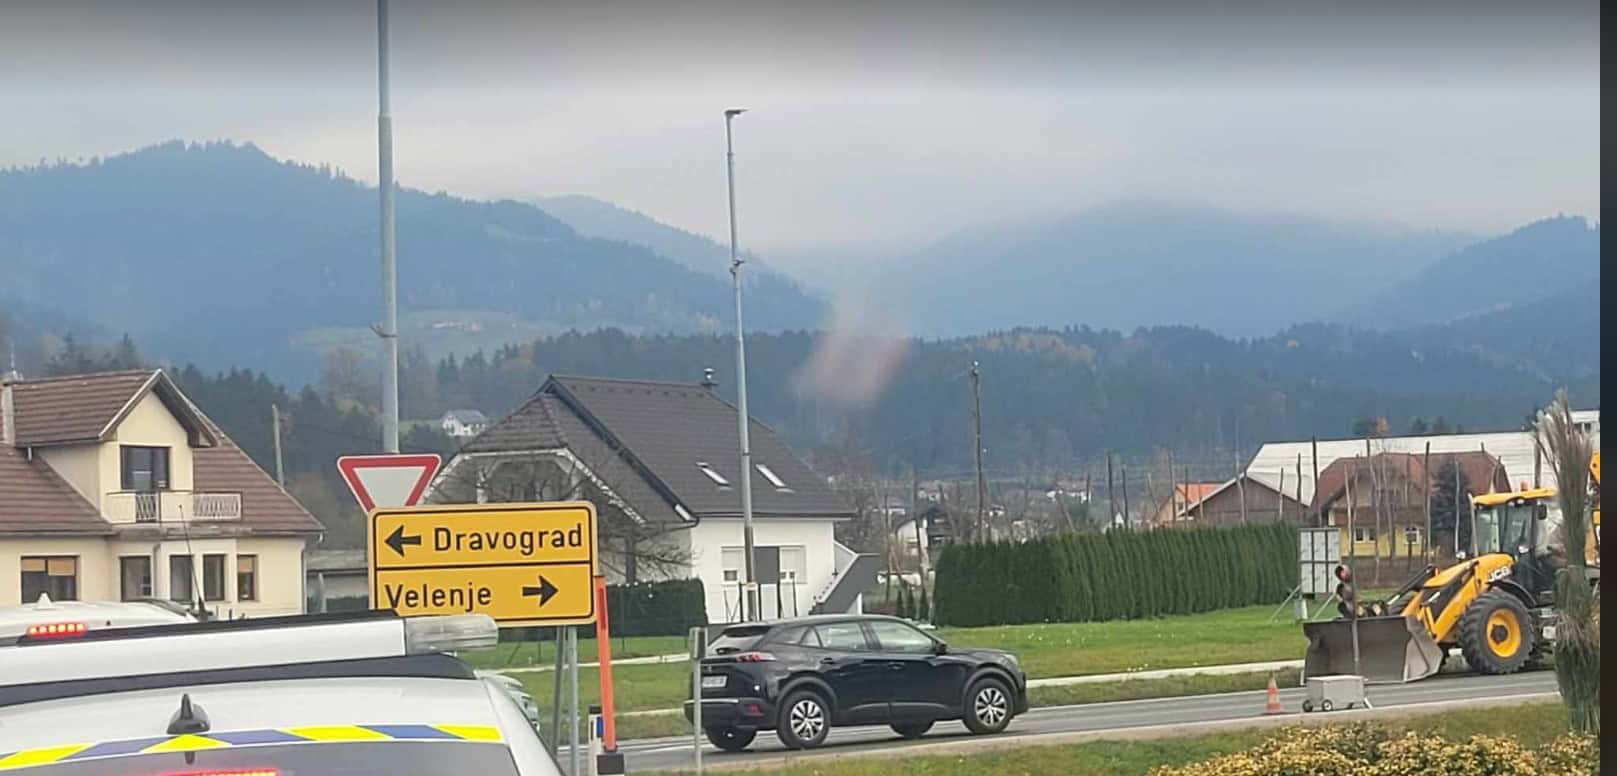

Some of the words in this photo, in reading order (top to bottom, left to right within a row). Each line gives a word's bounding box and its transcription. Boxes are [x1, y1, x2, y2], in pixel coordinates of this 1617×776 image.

[434, 523, 582, 556] Dravograd
[1487, 566, 1512, 582] JCB
[384, 581, 492, 612] Velenje
